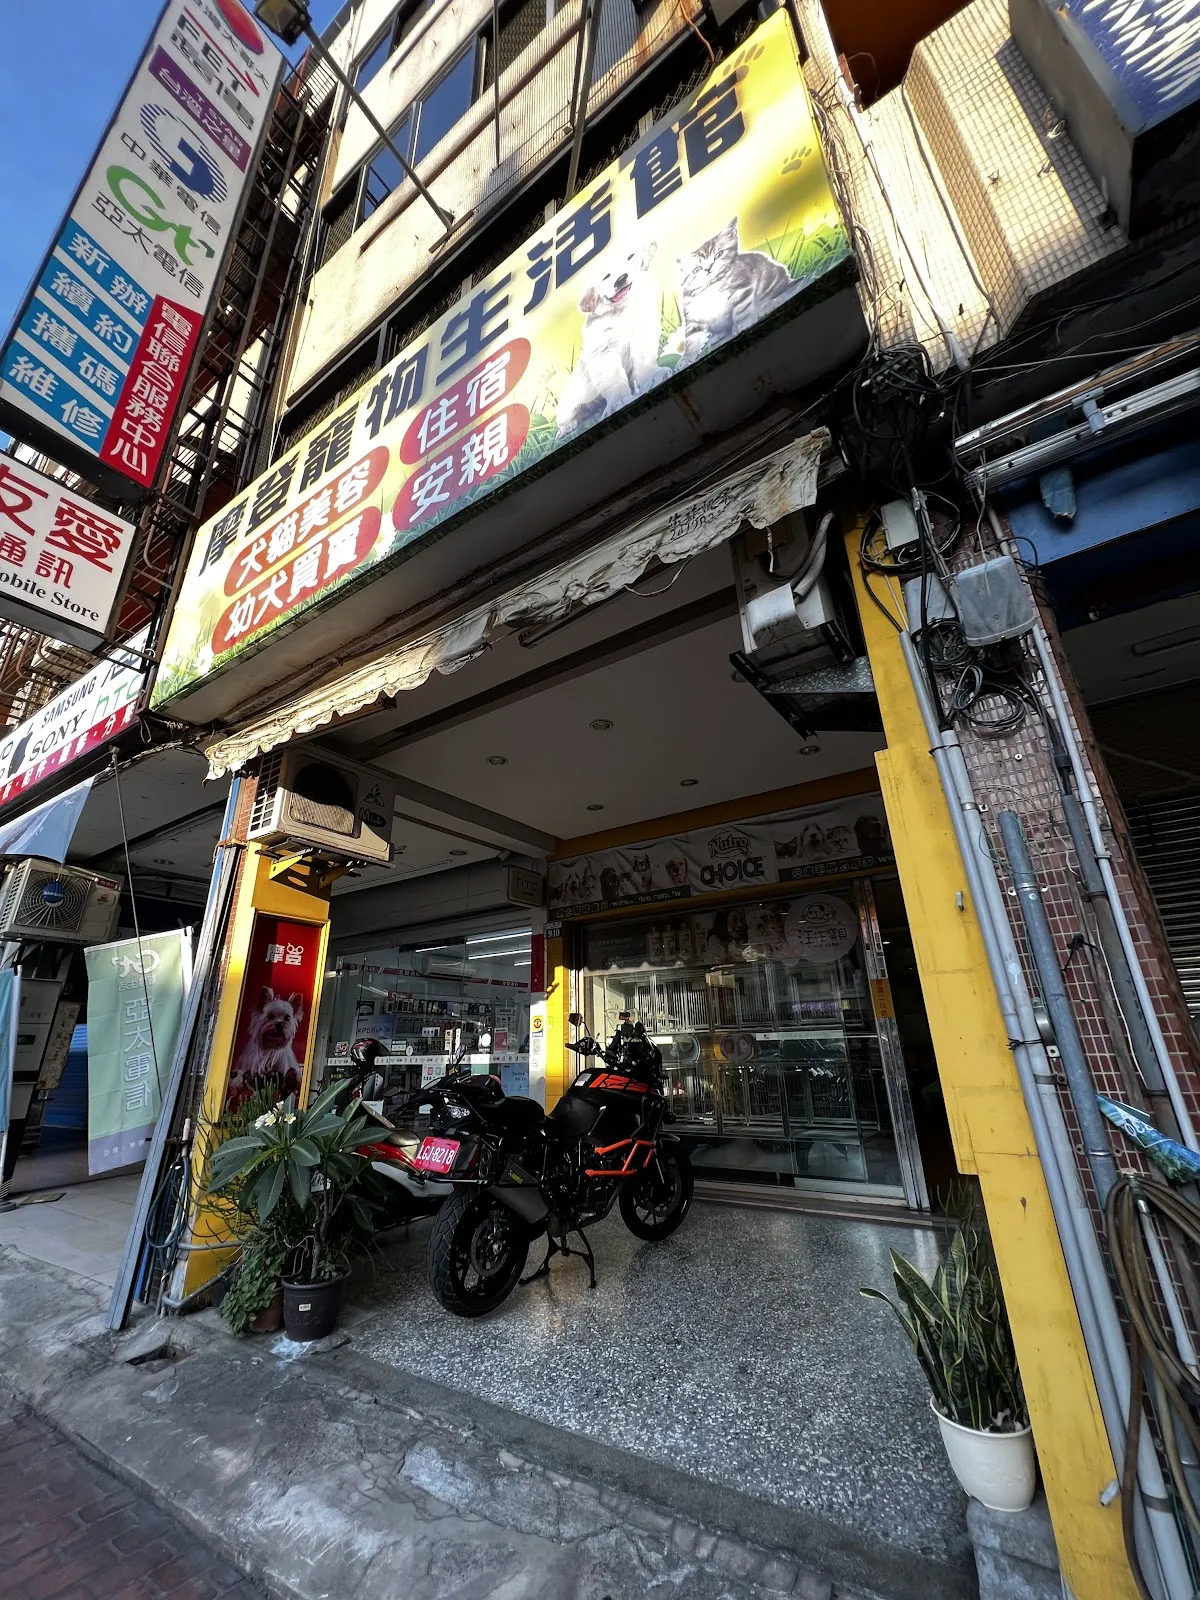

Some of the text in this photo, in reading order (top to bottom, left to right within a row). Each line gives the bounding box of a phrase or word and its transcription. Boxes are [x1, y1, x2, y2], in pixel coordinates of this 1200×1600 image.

[177, 13, 247, 92] FET
[208, 107, 244, 148] STAR
[120, 131, 222, 236] 中華電信
[68, 232, 149, 315] 新辦
[91, 190, 205, 298] 亞太電信
[51, 271, 133, 354] 續約
[8, 355, 104, 439] 維修
[110, 301, 193, 477] 電信聯合服務中心
[416, 350, 511, 454] 住宿
[408, 413, 510, 525] 安親
[0, 463, 124, 574] 友愛
[235, 459, 370, 588] 犬貓美容
[50, 591, 100, 622] Store
[224, 514, 364, 642] 幼犬買賣
[29, 709, 87, 762] SONY
[41, 676, 97, 728] SAMSUNG
[700, 856, 765, 885] CHOICE
[708, 833, 751, 858] Nutro
[417, 1145, 455, 1165] LGJ-8218
